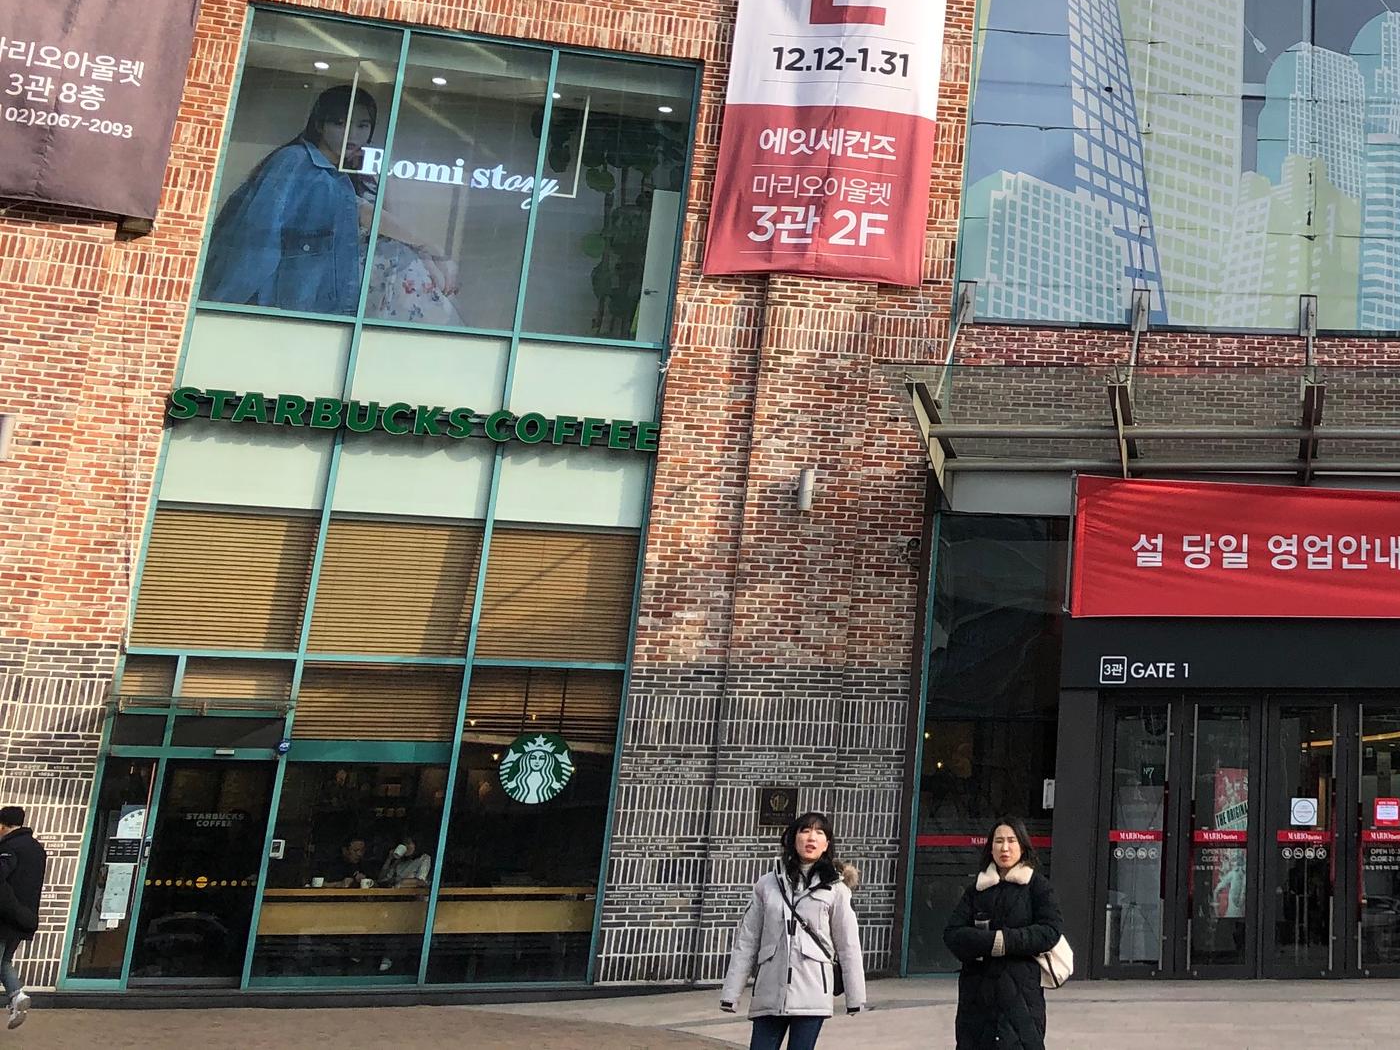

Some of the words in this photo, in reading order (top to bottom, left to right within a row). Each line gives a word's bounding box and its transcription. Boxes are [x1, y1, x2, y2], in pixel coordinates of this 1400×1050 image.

[772, 45, 909, 78] 12.12-1.31
[5, 73, 54, 103] 3관
[59, 82, 106, 112] 8층
[759, 126, 896, 161] 에잇세컨즈
[356, 146, 463, 186] Romi
[471, 164, 560, 210] story
[752, 172, 891, 207] 마리오아울렛
[748, 204, 819, 247] 3관
[829, 208, 888, 247] 2F
[168, 386, 475, 438] STARBUCKS
[484, 411, 661, 452] COFFEE
[1132, 533, 1164, 568] 설
[1182, 533, 1249, 570] 당일
[1103, 663, 1123, 677] 3관
[1130, 662, 1177, 679] GATE
[1183, 662, 1190, 679] 1
[185, 813, 244, 821] STARBUCKS
[196, 820, 232, 828] COFFEE
